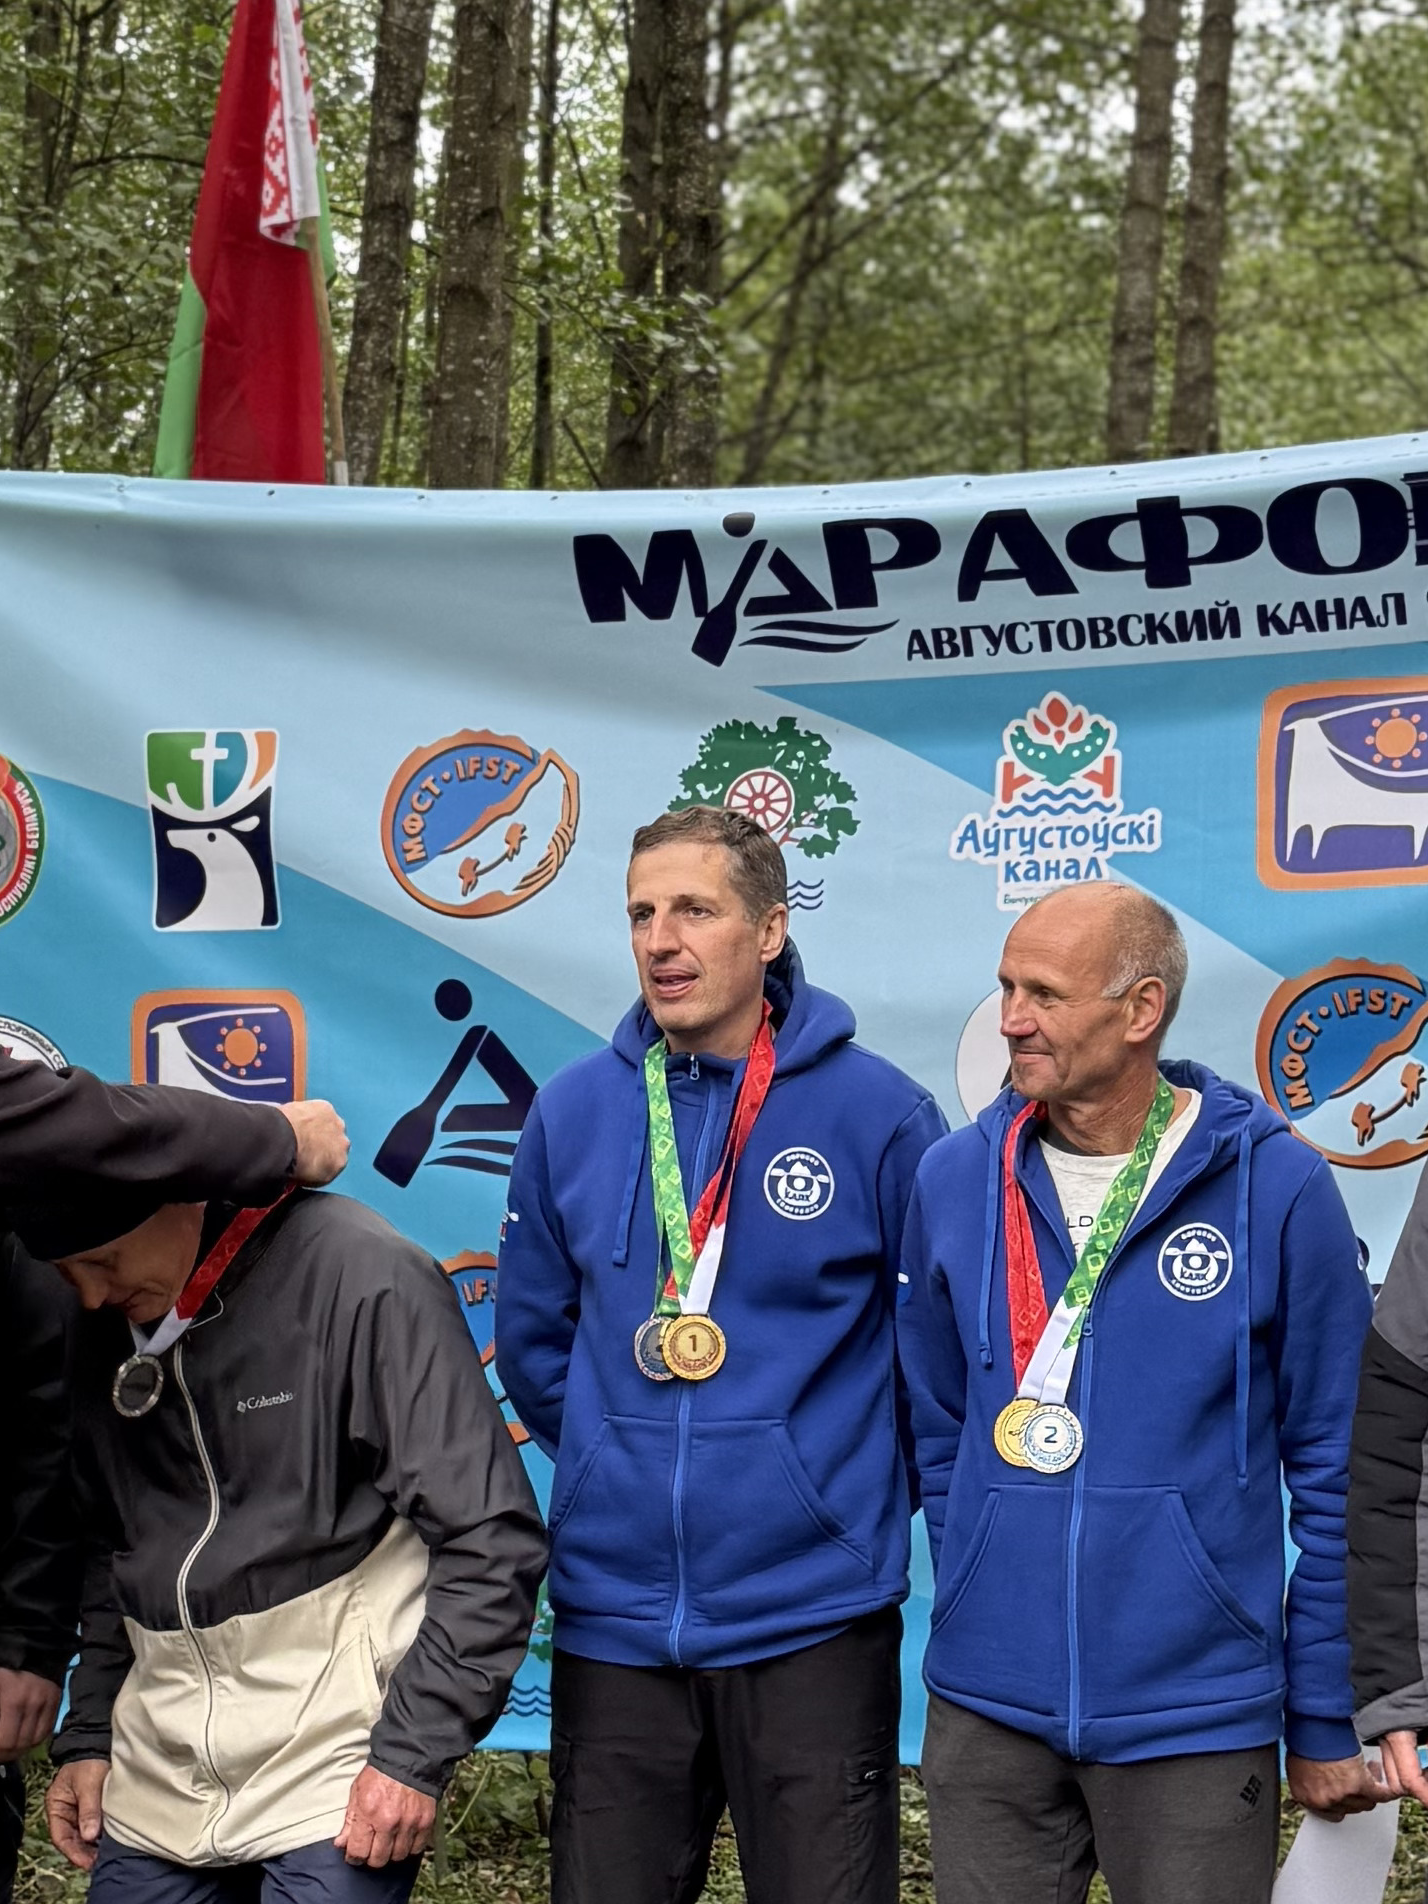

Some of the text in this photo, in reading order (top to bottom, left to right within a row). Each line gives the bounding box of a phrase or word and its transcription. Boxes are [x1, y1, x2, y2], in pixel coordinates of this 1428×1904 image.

[905, 598, 1241, 662] АВГУСТОВСКИЙ
[1256, 591, 1409, 637] КАНАЛ
[1003, 856, 1104, 884] канал
[687, 1333, 699, 1353] 1
[1043, 1425, 1058, 1444] 2
